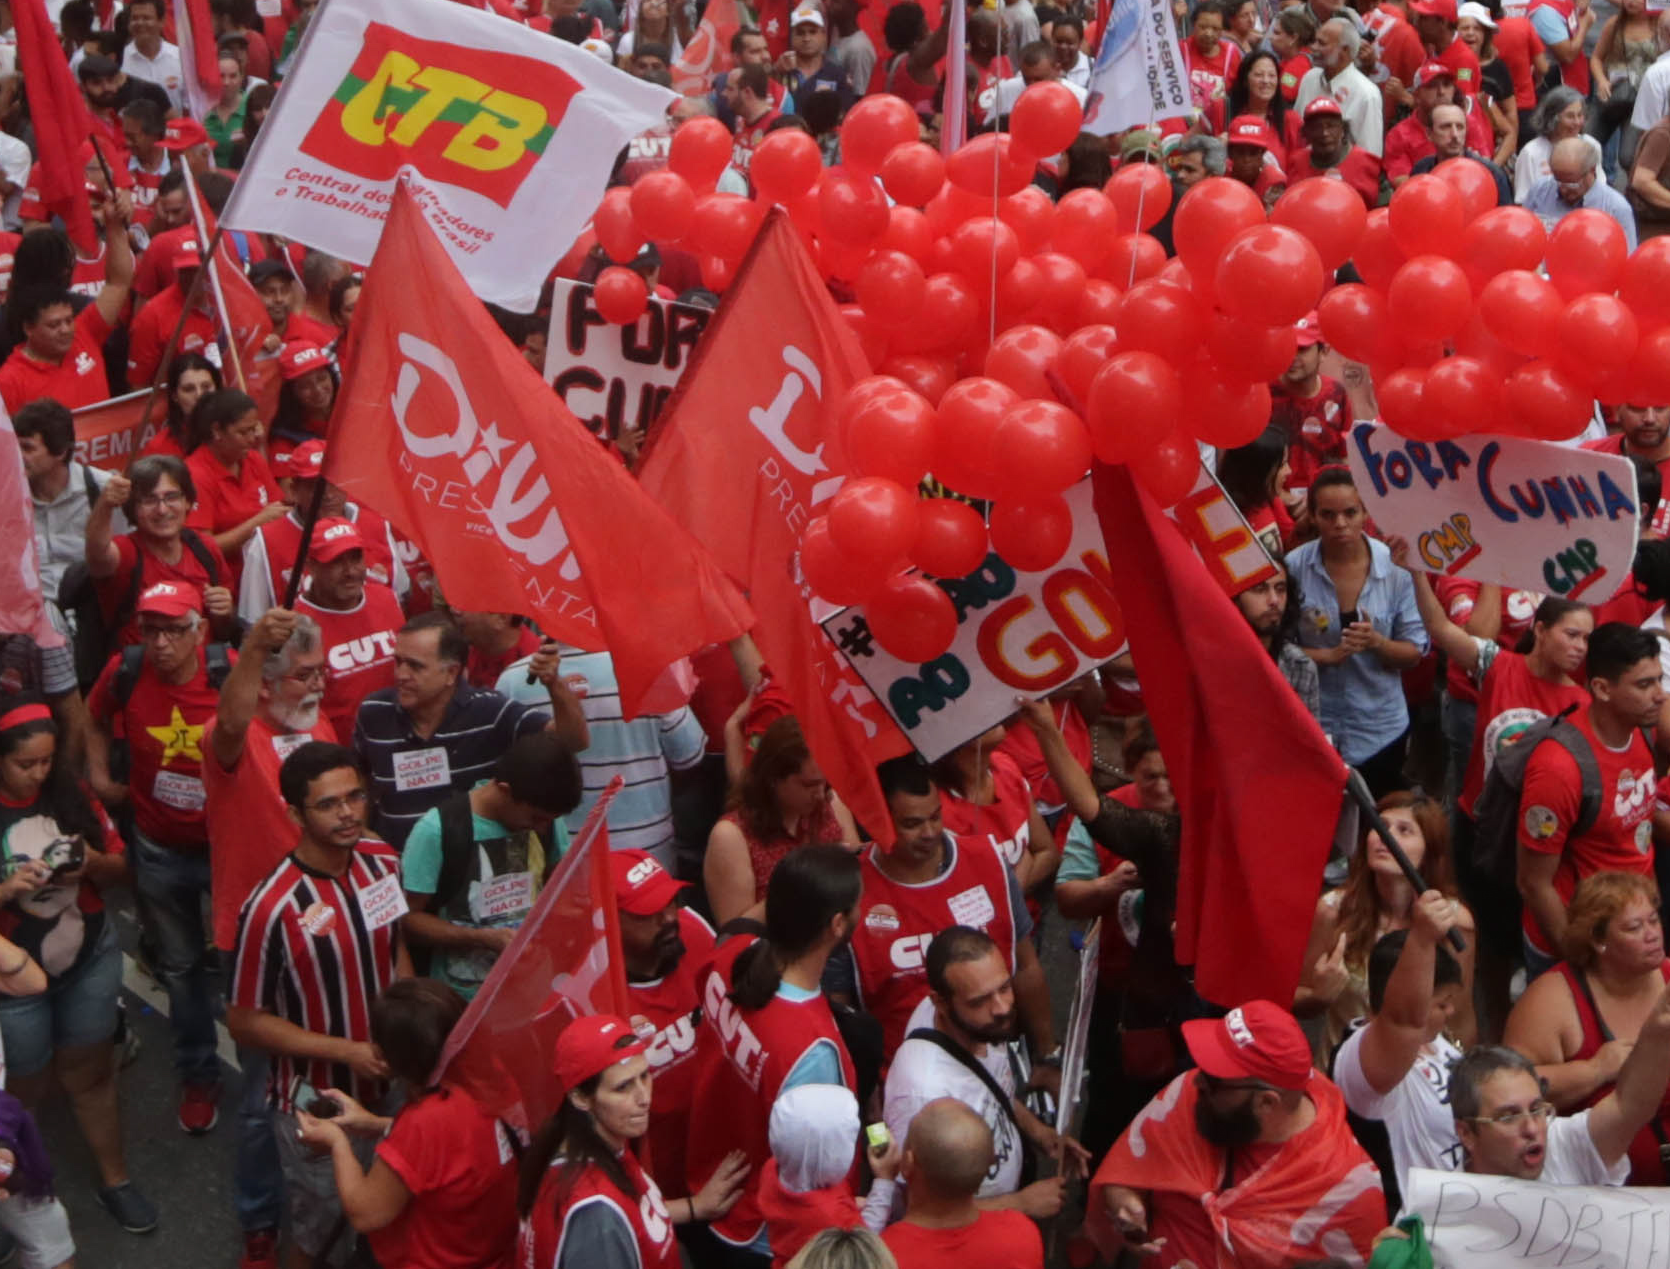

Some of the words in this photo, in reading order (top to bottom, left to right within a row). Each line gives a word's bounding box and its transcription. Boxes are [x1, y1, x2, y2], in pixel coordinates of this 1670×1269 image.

[340, 51, 548, 172] CTB
[283, 167, 361, 200] Central
[565, 284, 716, 371] FOR
[1352, 422, 1472, 498] FORA
[1476, 440, 1637, 526] CUNHA
[1417, 512, 1478, 571] CMP
[1542, 537, 1600, 595] CMP
[328, 626, 398, 672] CUT
[888, 651, 971, 730] AO
[396, 754, 444, 773] GOLPE
[483, 878, 531, 900] GOLPE
[1222, 1007, 1256, 1050] CUT
